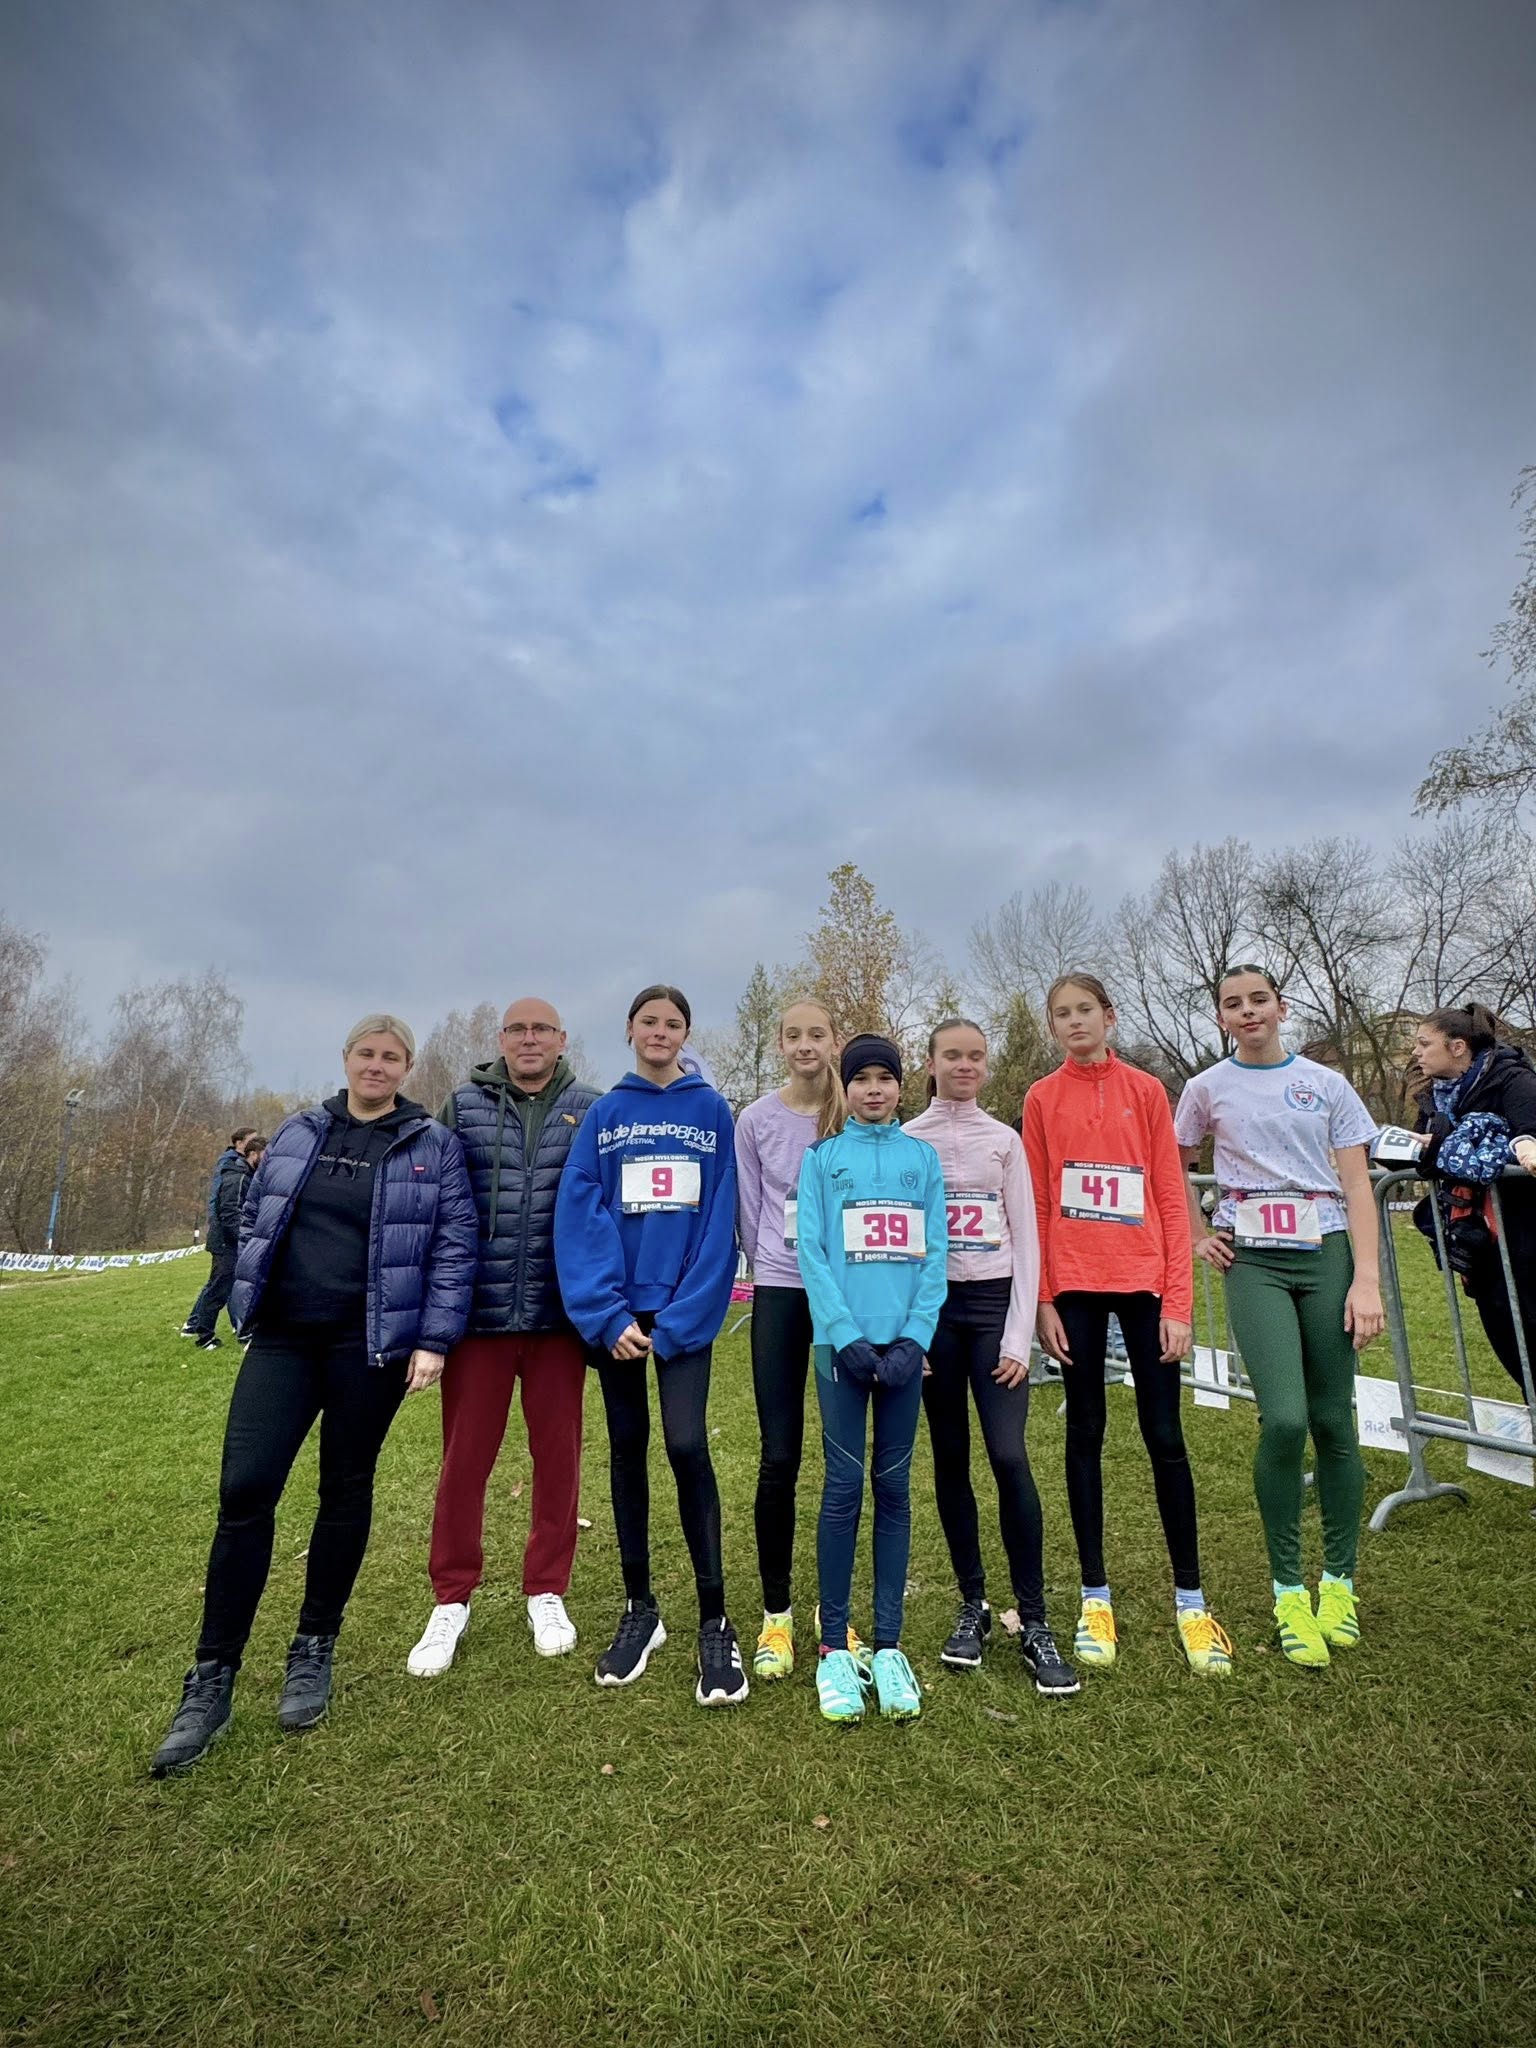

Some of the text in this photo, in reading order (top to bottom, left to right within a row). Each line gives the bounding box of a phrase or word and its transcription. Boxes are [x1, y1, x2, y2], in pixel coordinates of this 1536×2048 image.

[598, 1128, 612, 1145] rio
[613, 1124, 630, 1141] de
[628, 1121, 678, 1139] janeiro
[626, 1137, 656, 1145] FESTIVAL
[652, 1167, 672, 1197] 9
[1082, 1175, 1119, 1207] 41
[863, 1213, 908, 1247] 39
[946, 1204, 983, 1237] 22
[1258, 1203, 1297, 1235] 10
